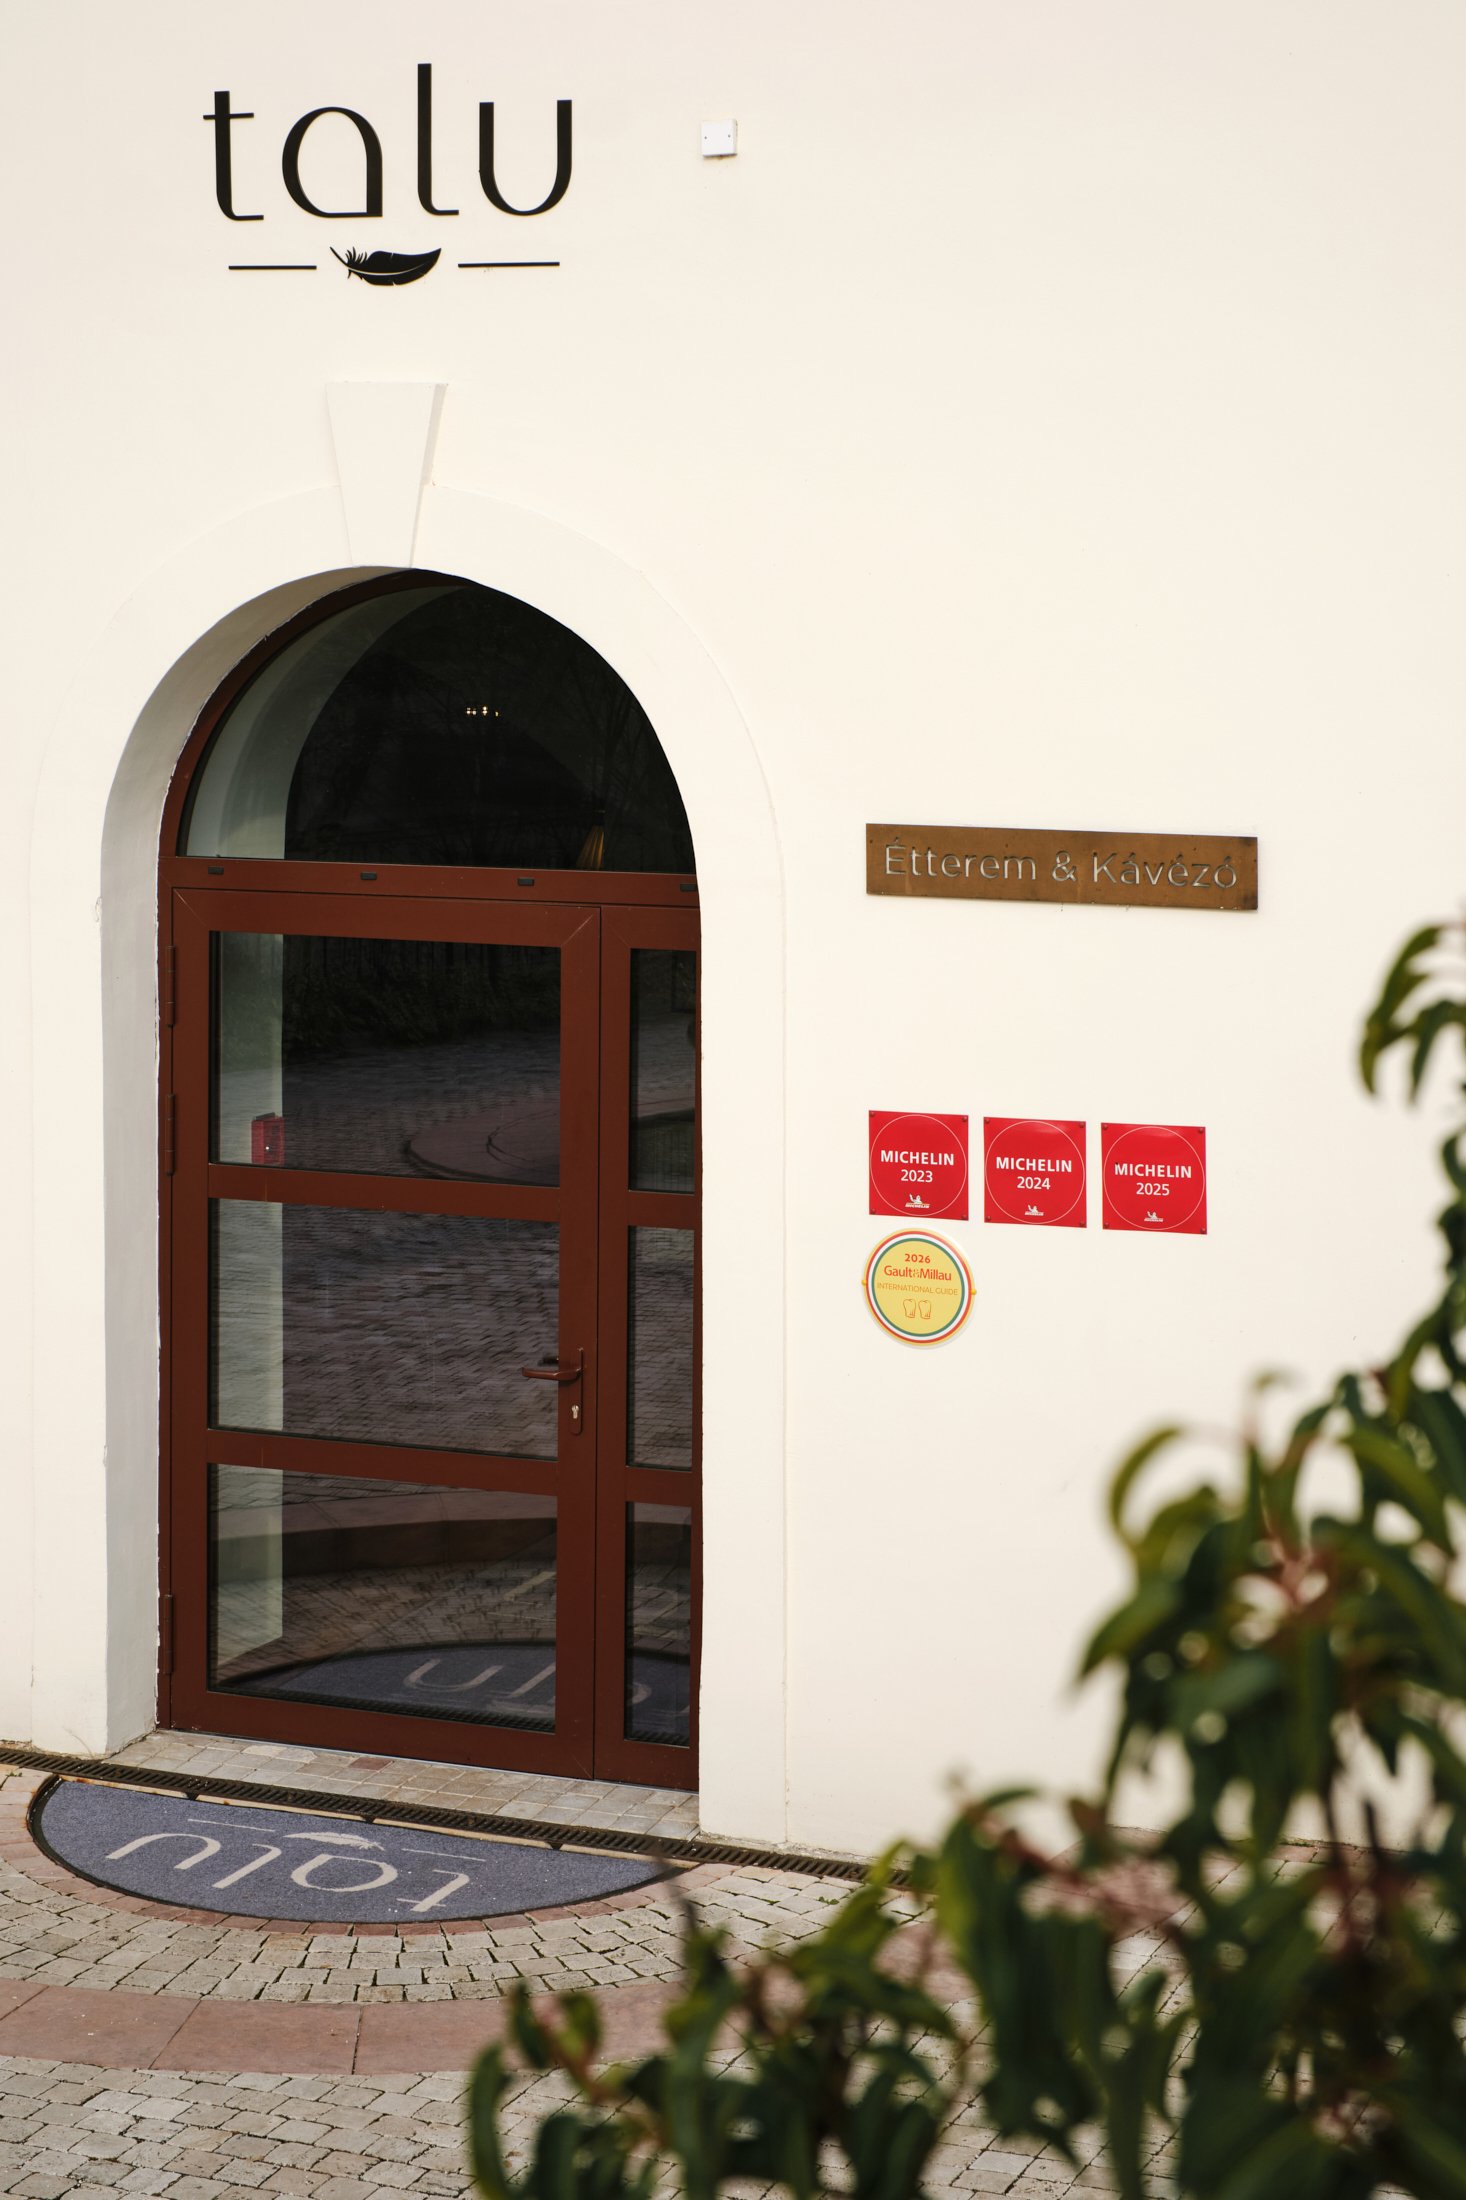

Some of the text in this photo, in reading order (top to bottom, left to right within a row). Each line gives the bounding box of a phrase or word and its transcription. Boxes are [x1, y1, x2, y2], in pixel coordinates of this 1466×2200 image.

[203, 63, 573, 221] talu
[885, 837, 1238, 889] Étterem & Kávézó
[880, 1150, 955, 1166] MICHELIN
[996, 1157, 1072, 1173] MICHELIN
[900, 1169, 933, 1183] 2023
[1114, 1163, 1192, 1179] MICHELIN
[1016, 1176, 1051, 1190] 2024
[1136, 1182, 1170, 1196] 2025
[904, 1253, 931, 1264] 2026
[877, 1282, 959, 1296] INTERNATIONAL GUIDE
[105, 1832, 471, 1913] talu
